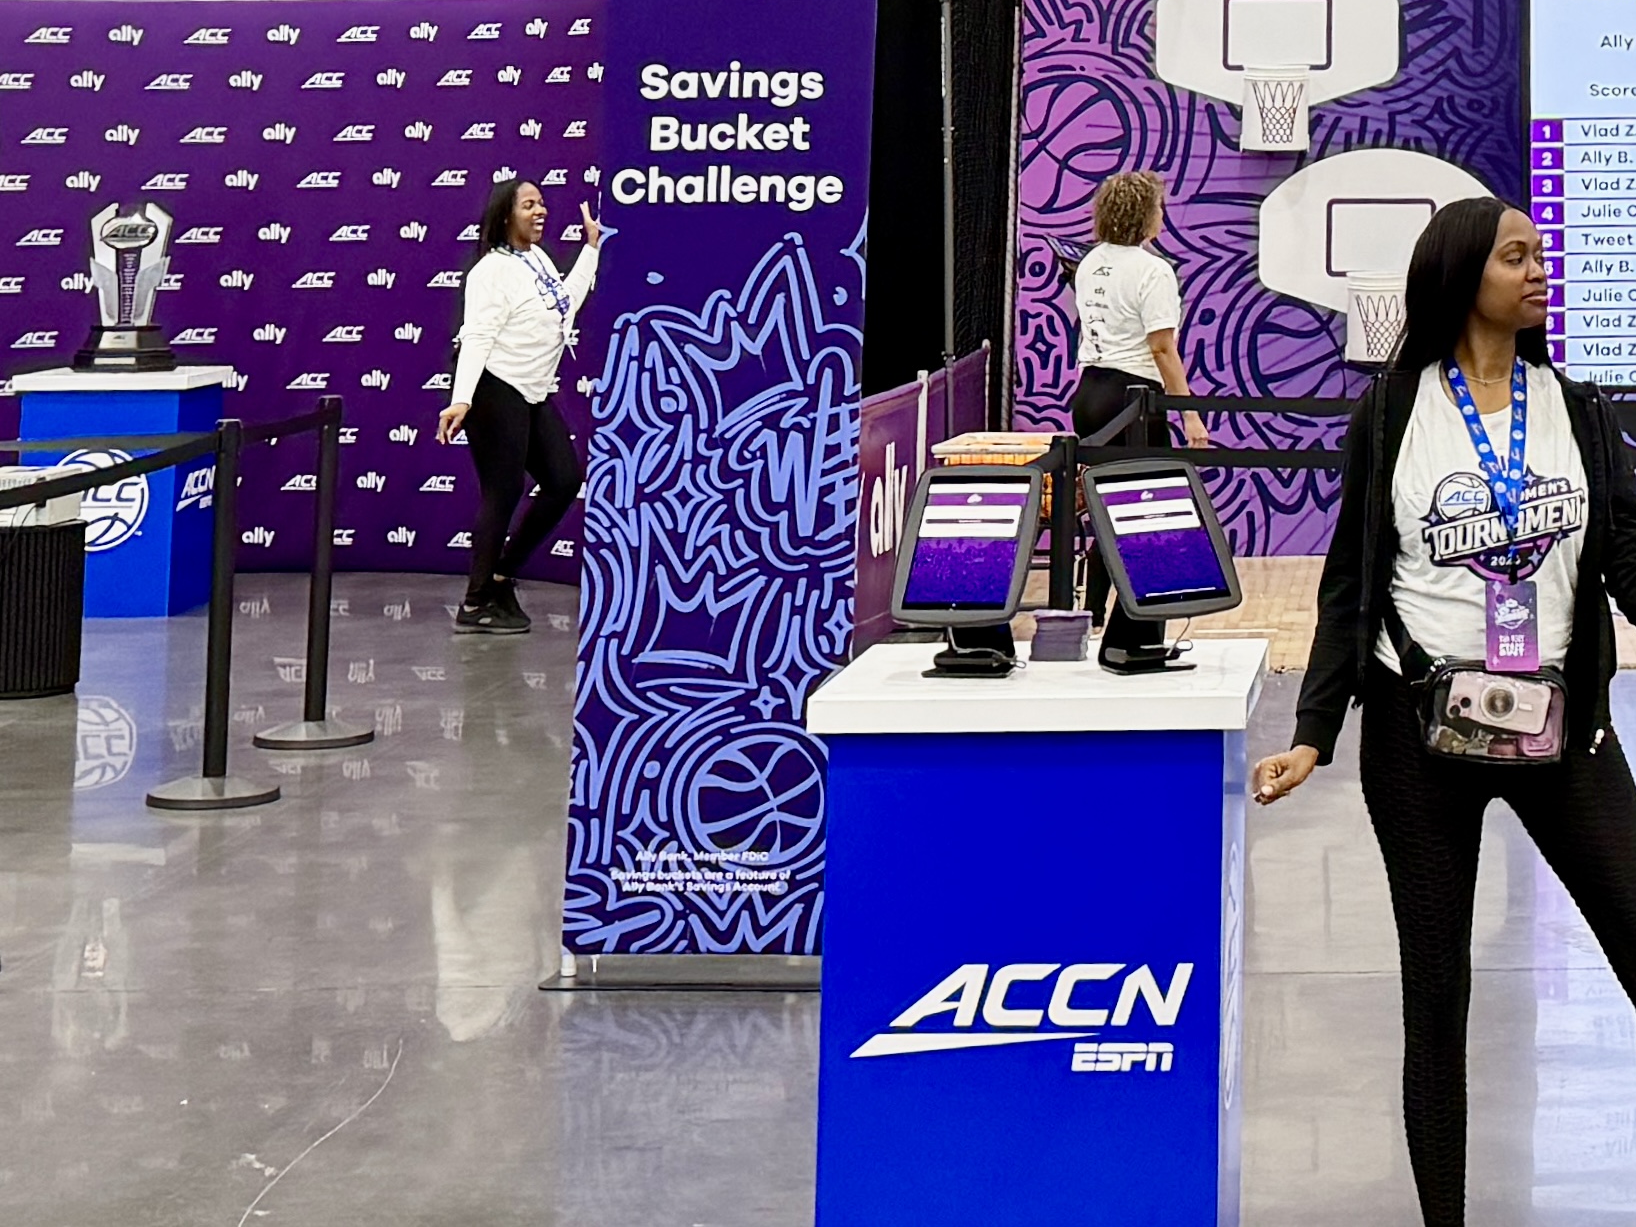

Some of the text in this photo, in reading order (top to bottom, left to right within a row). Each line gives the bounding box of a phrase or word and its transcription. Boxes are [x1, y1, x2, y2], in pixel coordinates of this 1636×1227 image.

[23, 18, 549, 46] ACC ally ACC ally ACC ally
[1601, 34, 1633, 51] Ally
[69, 65, 522, 92] ally ACC ally ACC ally
[640, 60, 825, 108] Savings
[20, 124, 228, 146] ACC ally ACC
[650, 113, 811, 152] Bucket
[1542, 125, 1551, 137] 1
[1581, 124, 1620, 137] Vlad
[1541, 152, 1553, 165] 2
[1580, 151, 1613, 166] Ally
[1617, 151, 1634, 164] B.
[65, 170, 102, 192] ally
[140, 173, 190, 191] ACC
[430, 169, 469, 186] ACC
[611, 165, 844, 212] Challenge
[1541, 179, 1553, 193] 3
[1581, 178, 1620, 191] Vlad
[1541, 206, 1554, 221] 4
[1581, 204, 1622, 218] Julie
[15, 228, 64, 247] ACC
[174, 226, 224, 244] ACC
[399, 221, 428, 243] ally
[1582, 232, 1634, 246] Tweet
[291, 271, 336, 289] ACC
[366, 268, 396, 290] ally
[426, 271, 464, 288] ACC
[1581, 260, 1614, 276] Ally
[1619, 260, 1635, 274] B.
[1582, 288, 1623, 303] Julie
[1582, 314, 1622, 328] Vlad
[10, 322, 423, 349] ACC ACC ACC ally
[1583, 343, 1623, 357] Vlad
[285, 369, 391, 391] ACC ally
[388, 424, 418, 446] ally
[82, 481, 143, 503] CC
[356, 471, 456, 493] ally ACC
[1520, 479, 1569, 502] MEN'S
[1440, 489, 1486, 507] ACC
[1424, 489, 1584, 561] TOURNMENT
[241, 526, 275, 548] ally
[386, 526, 416, 547] ally
[635, 851, 657, 862] Ally
[888, 962, 1194, 1028] ACCN
[1071, 1042, 1174, 1072] ESPN
